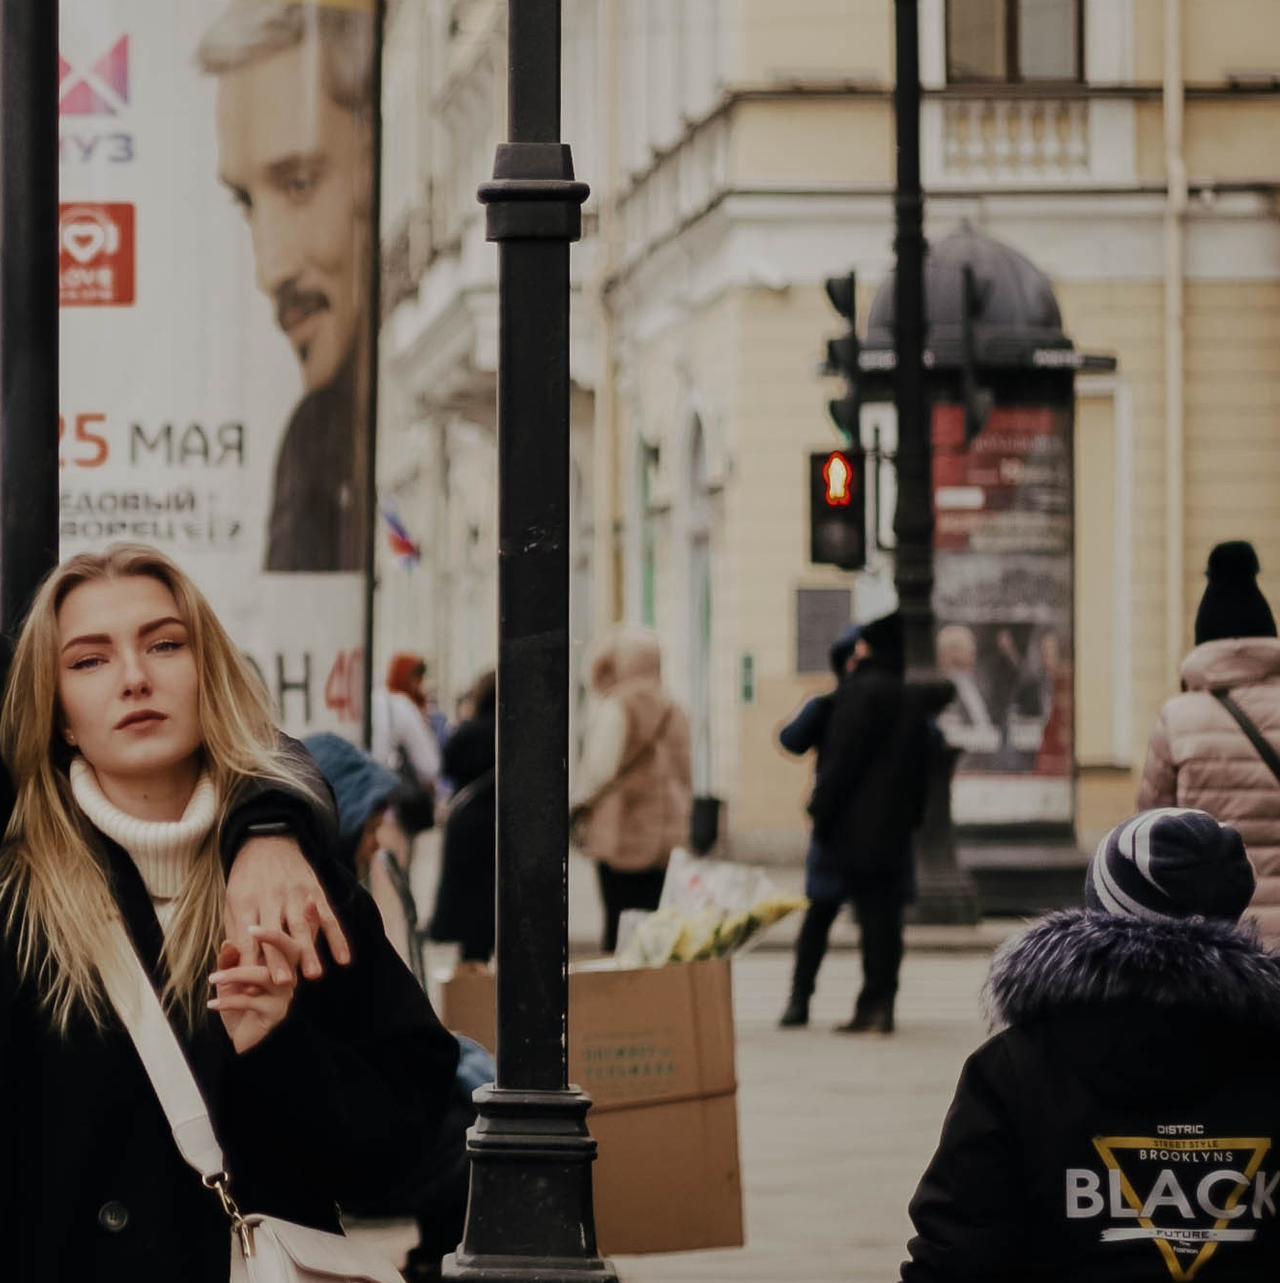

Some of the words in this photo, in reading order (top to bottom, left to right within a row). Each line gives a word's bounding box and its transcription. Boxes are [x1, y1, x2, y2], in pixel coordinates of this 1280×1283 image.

[129, 421, 245, 466] МАЯ
[1157, 1124, 1204, 1135] DISTRIC
[1154, 1139, 1187, 1149] STREET
[1189, 1140, 1219, 1149] STYLE
[1139, 1149, 1234, 1163] BROOKLYNS
[1065, 1168, 1280, 1219] BLACK
[1156, 1229, 1210, 1240] FUTURE
